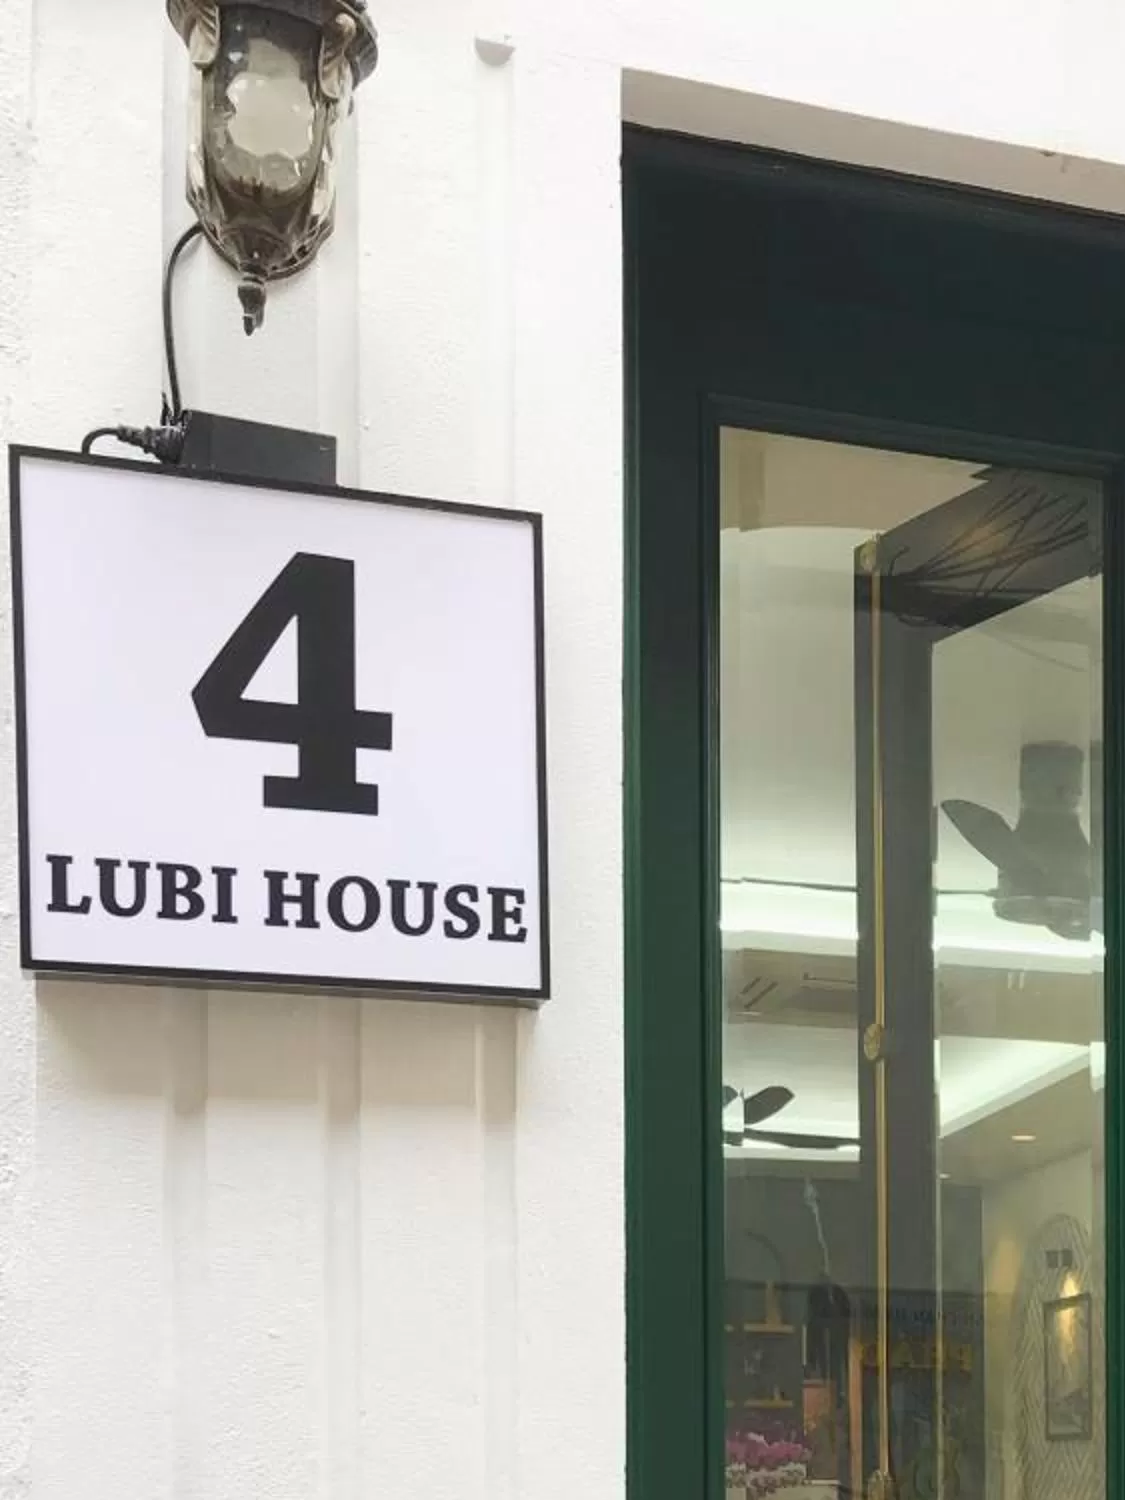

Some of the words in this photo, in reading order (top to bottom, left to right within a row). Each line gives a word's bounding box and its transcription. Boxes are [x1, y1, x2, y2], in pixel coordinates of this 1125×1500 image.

[191, 551, 393, 816] 4
[46, 854, 238, 924] LUBI
[263, 870, 528, 943] HOUSE
